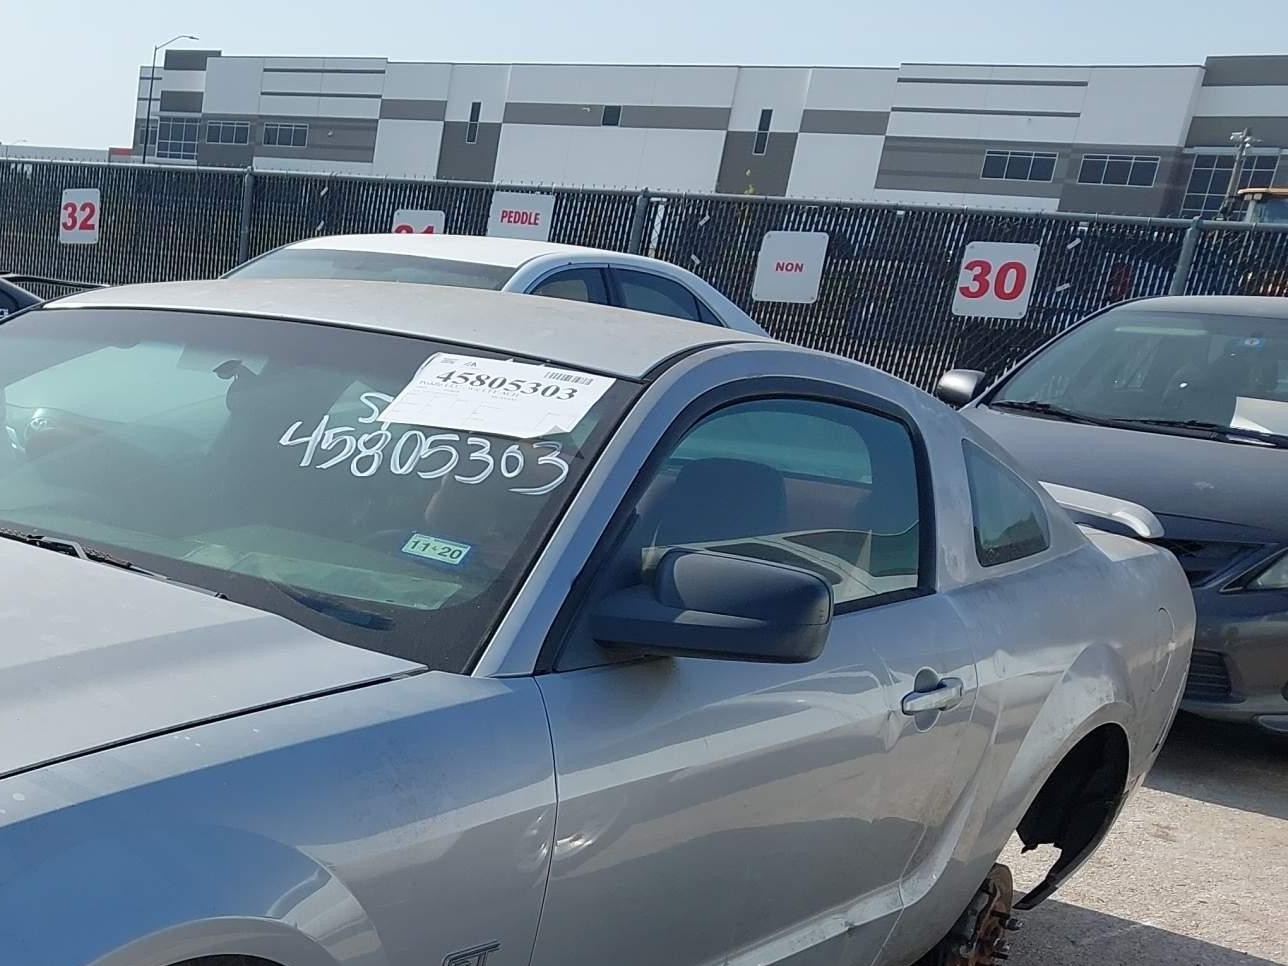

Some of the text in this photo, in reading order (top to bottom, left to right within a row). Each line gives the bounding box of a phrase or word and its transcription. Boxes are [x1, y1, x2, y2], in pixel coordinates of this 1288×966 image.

[62, 202, 95, 232] 32
[499, 209, 541, 226] PEDDLE
[774, 261, 805, 273] NON
[958, 258, 1028, 302] 30
[436, 369, 578, 401] 45805303
[279, 415, 570, 496] 45805303
